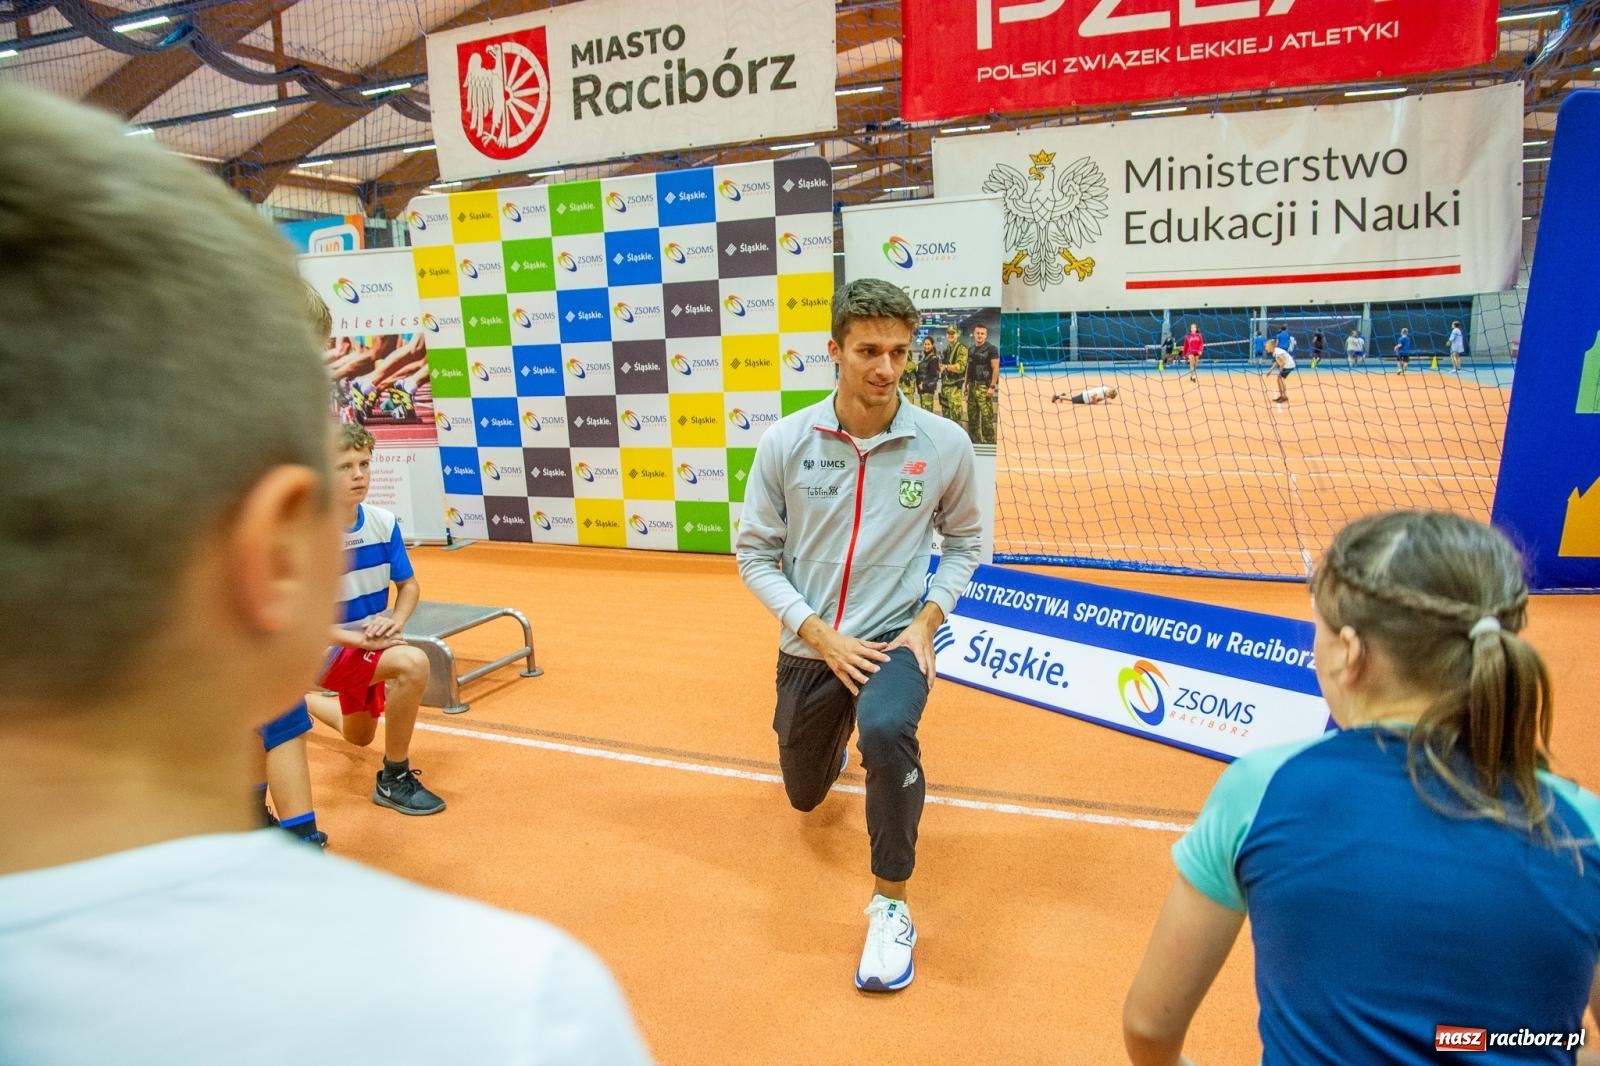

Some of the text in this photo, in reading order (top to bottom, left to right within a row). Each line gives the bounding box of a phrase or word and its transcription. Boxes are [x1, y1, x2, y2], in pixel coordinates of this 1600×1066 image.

[571, 24, 686, 69] MIASTO
[976, 20, 1399, 83] POLSKI ZWIĄZEK LEKKIEJ ATLETYKI
[571, 47, 798, 121] Racibórz
[1125, 147, 1408, 194] Ministerstwo
[742, 181, 771, 193] ZSOMS
[627, 194, 654, 204] ZSOMS
[522, 205, 546, 214] ZSOMS
[426, 214, 449, 222] ZSOMS
[1125, 189, 1461, 246] Edukacji i Nauki
[803, 235, 832, 246] ZSOMS
[686, 245, 714, 255] ZSOMS
[915, 241, 956, 255] ZSOMS
[577, 255, 603, 264] ZSOMS
[478, 262, 501, 271] ZSOMS
[360, 282, 393, 294] ZSOMS
[746, 298, 775, 309] ZSOMS
[635, 305, 661, 315] ZSOMS
[531, 312, 556, 321] ZSOMS
[340, 314, 419, 330] hletics
[439, 317, 460, 326] ZSOMS
[692, 359, 719, 368] ZSOMS
[805, 354, 832, 364] ZSOM
[489, 366, 512, 375] ZSOMS
[586, 363, 611, 371] ZSOMS
[541, 416, 565, 424] ZSOMS
[641, 416, 667, 424] ZSOMS
[750, 414, 779, 422] ZSOMS
[820, 459, 846, 468] UMCS
[500, 466, 522, 474] ZSOMS
[594, 468, 619, 476] ZSOMS
[697, 469, 724, 477] ZSOMS
[463, 513, 484, 521] ZSOMS
[551, 517, 574, 525] ZSOMS
[648, 520, 674, 529] ZSOMS
[1073, 602, 1202, 646] SPORTOWEGO
[1205, 631, 1223, 650] w
[1226, 631, 1317, 670] Raciborz
[963, 630, 1070, 689] Śląskie.
[1173, 687, 1256, 725] ZSOMS
